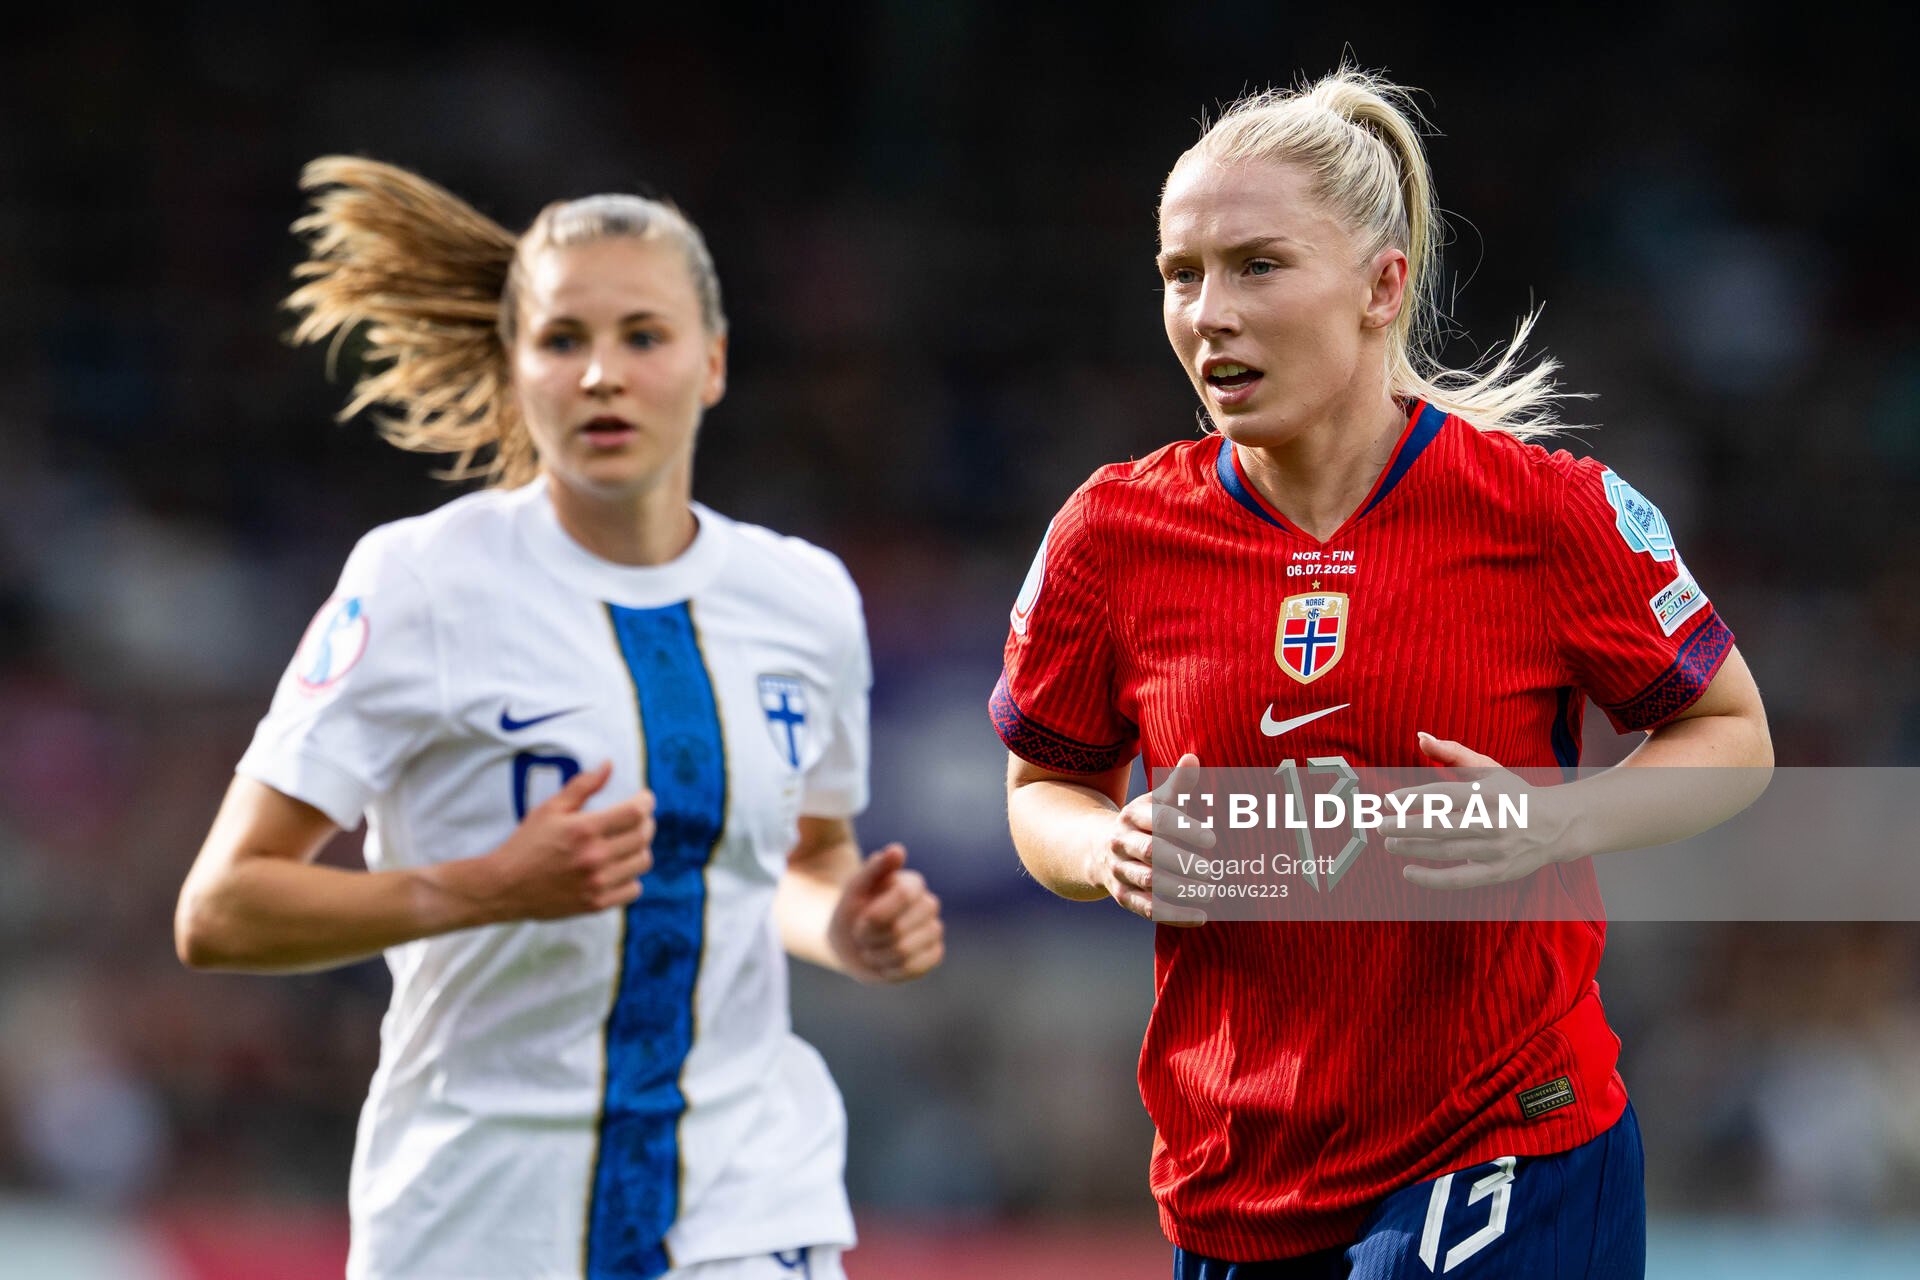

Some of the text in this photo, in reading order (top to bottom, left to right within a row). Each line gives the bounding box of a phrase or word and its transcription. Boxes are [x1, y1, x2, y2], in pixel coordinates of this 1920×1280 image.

[1292, 551, 1321, 561] NOR
[1332, 550, 1355, 561] FIN
[1286, 564, 1357, 577] 06.07.2025
[1305, 598, 1325, 606] NORGE
[1654, 590, 1673, 609] UEFA
[1273, 756, 1368, 893] 13
[1419, 1156, 1517, 1274] 13
